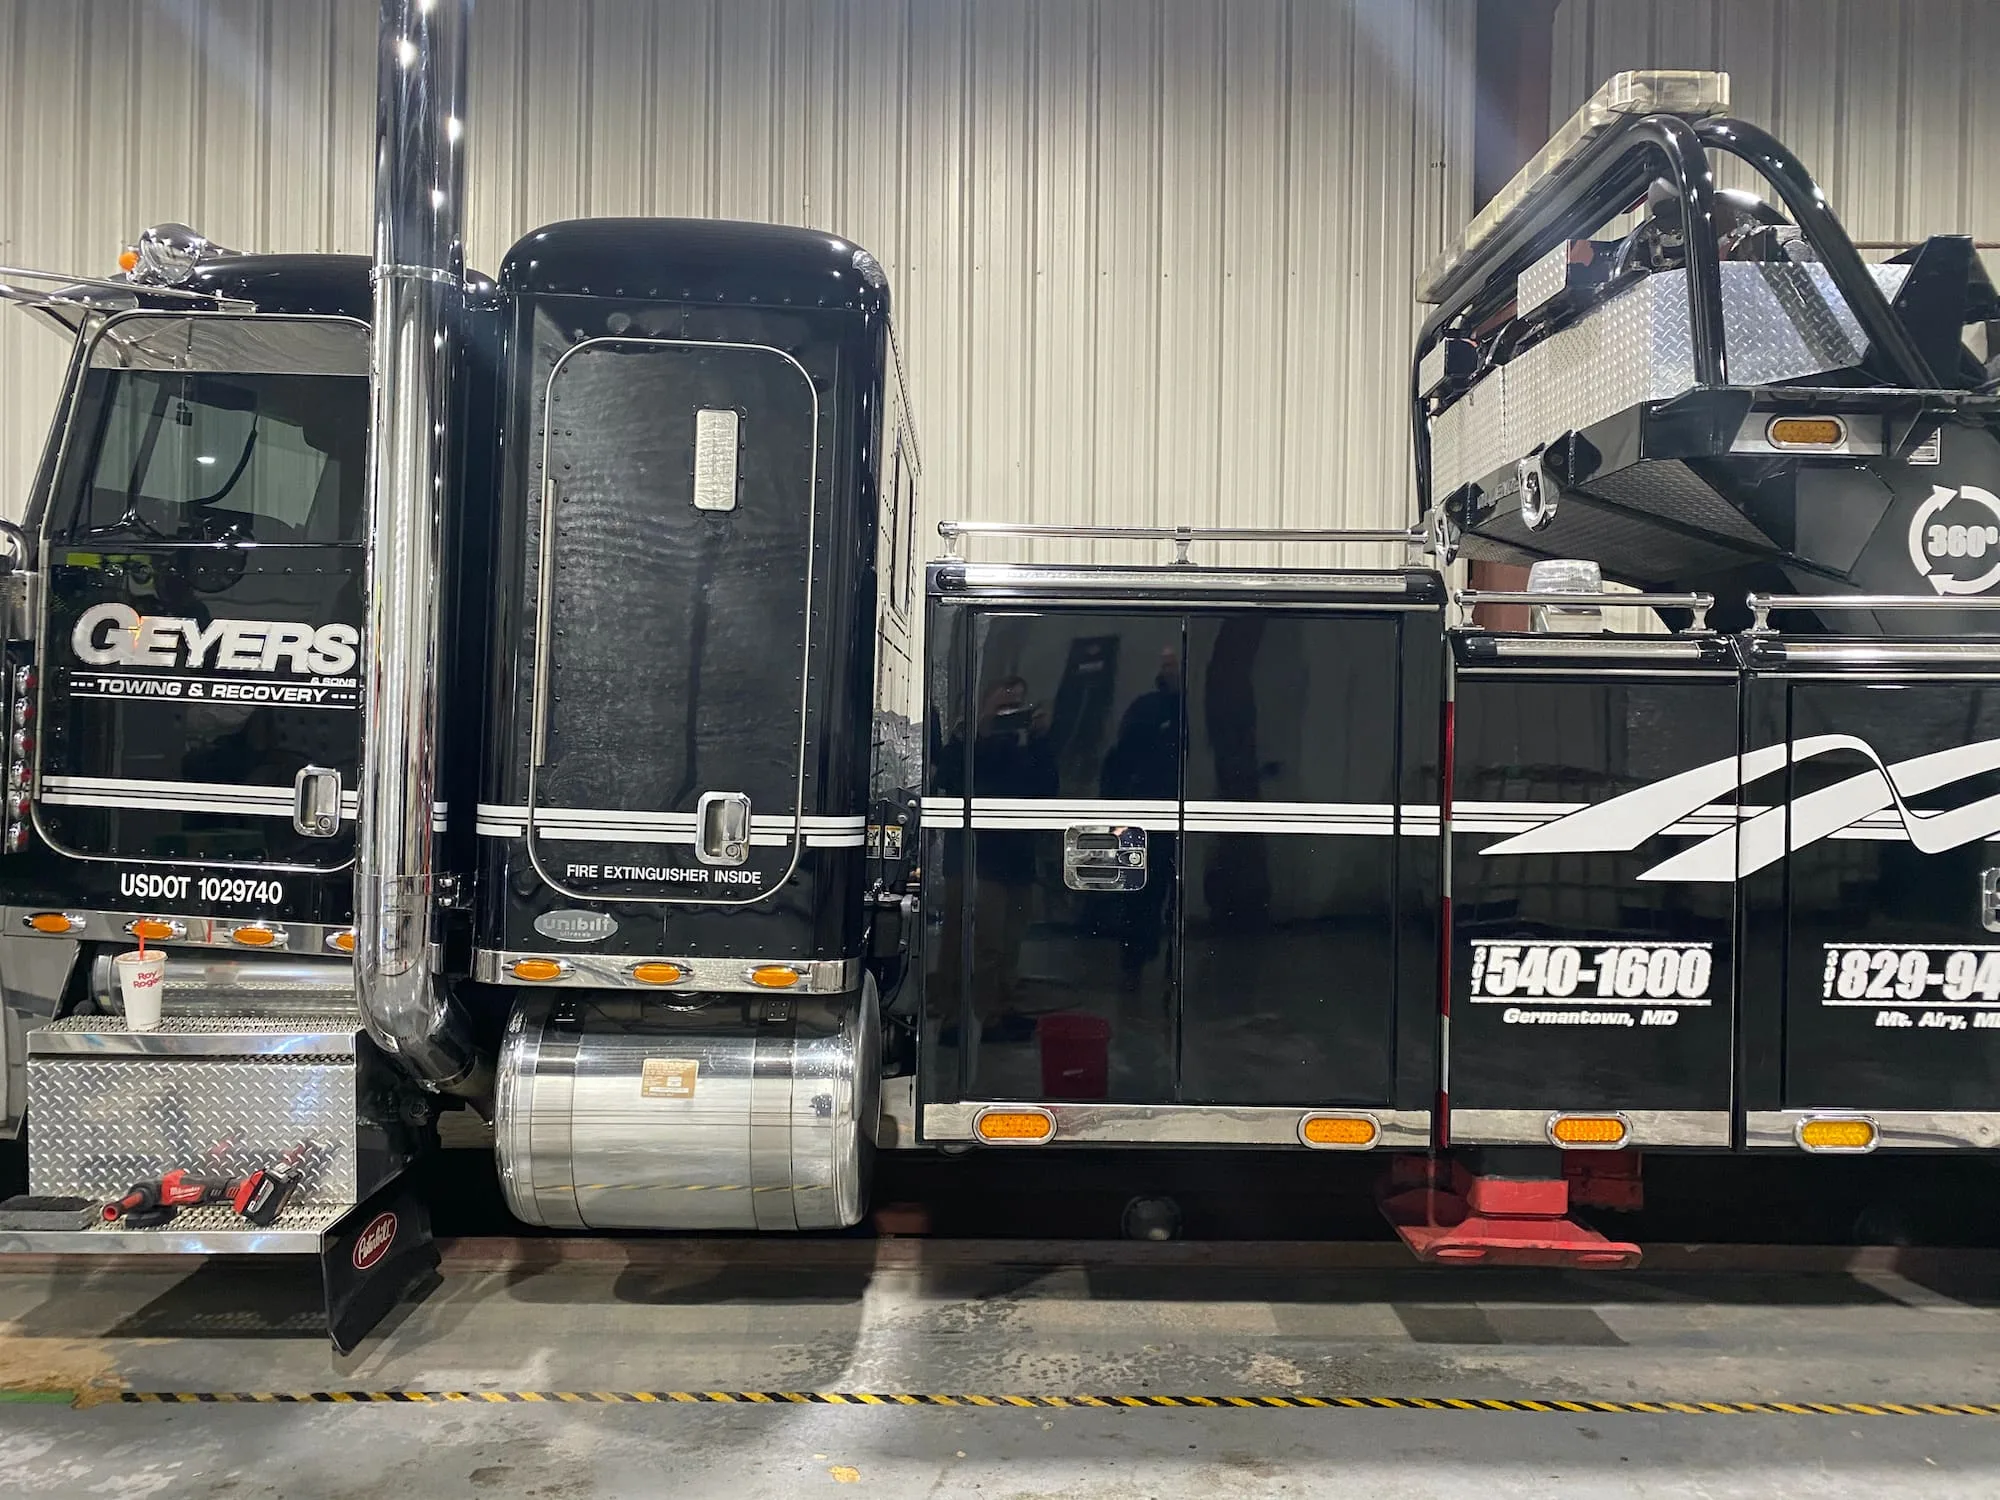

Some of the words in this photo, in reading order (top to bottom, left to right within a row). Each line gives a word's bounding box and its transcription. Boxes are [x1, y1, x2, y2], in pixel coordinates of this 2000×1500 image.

[71, 602, 359, 675] GEYERS
[97, 678, 182, 695] TOWING
[188, 682, 204, 697] &
[211, 684, 329, 702] RECOVERY
[566, 864, 598, 878] FIRE
[603, 866, 709, 882] EXTINGUISHER
[714, 870, 761, 884] INSIDE
[120, 873, 191, 899] USDOT
[197, 877, 283, 905] 1029740
[1484, 946, 1713, 998] 540-1600
[1502, 1007, 1635, 1027] Germantown,
[1640, 1009, 1679, 1026] MD
[1875, 1011, 1913, 1027] Mt.
[1917, 1011, 1968, 1031] Airy,
